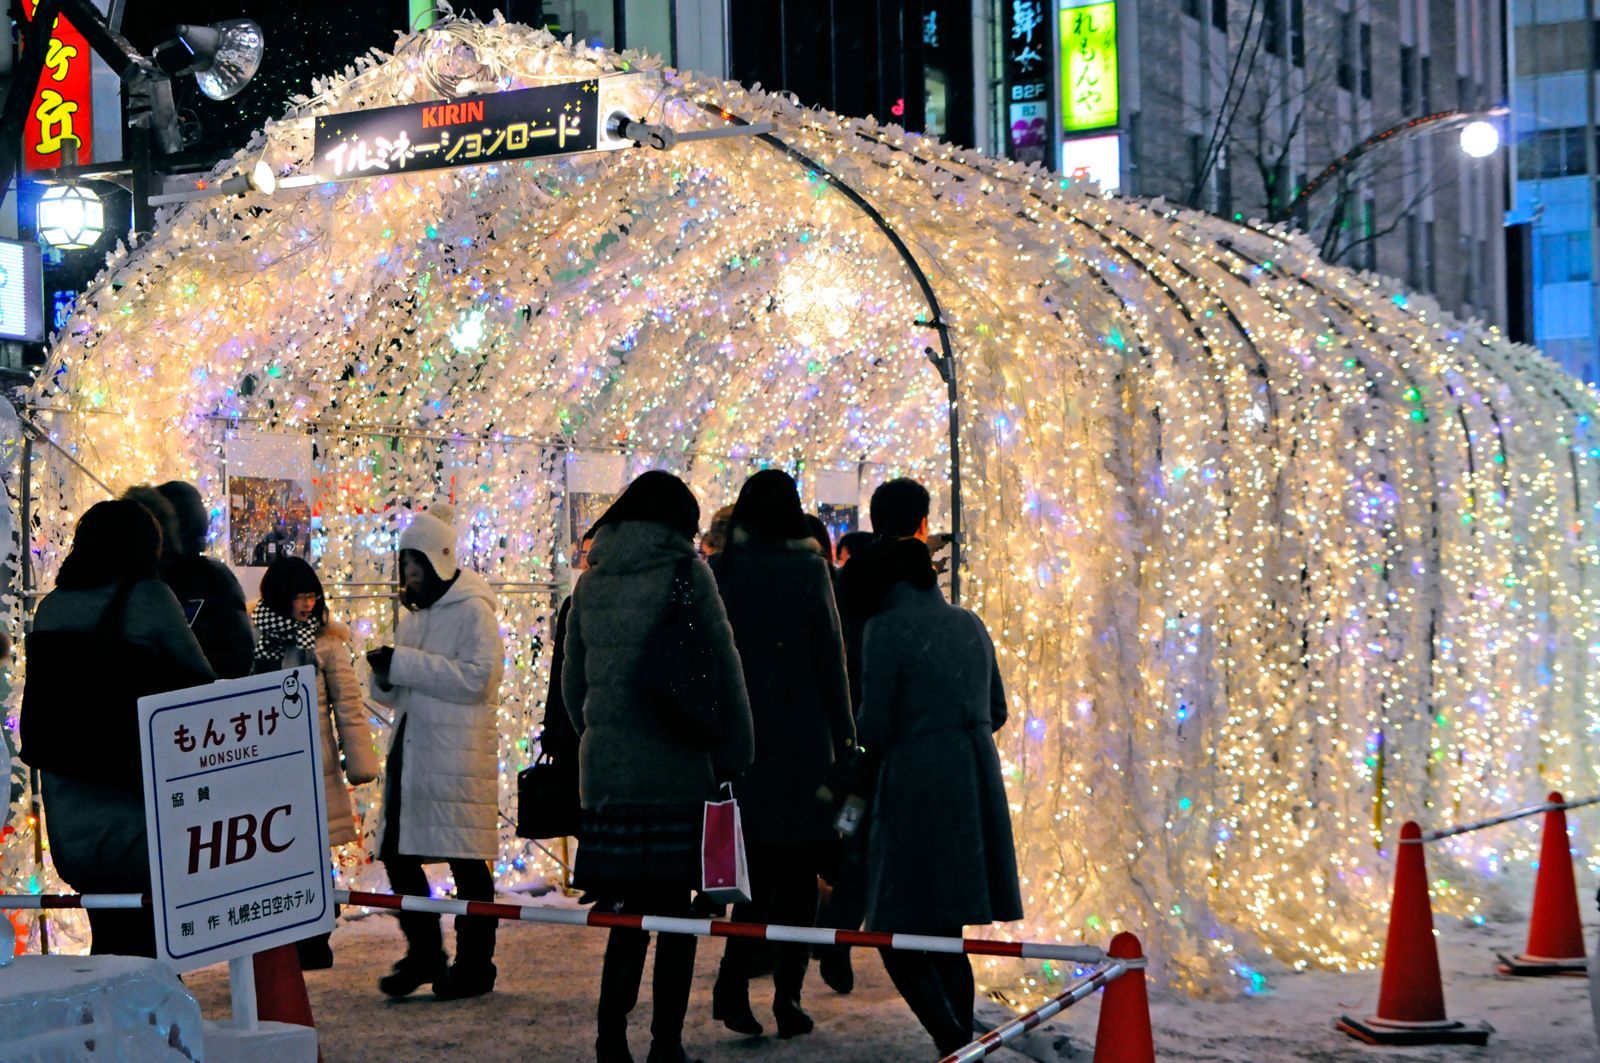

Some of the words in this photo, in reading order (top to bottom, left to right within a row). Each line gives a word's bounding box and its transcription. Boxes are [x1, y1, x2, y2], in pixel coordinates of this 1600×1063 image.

[1073, 12, 1102, 111] れもんや
[1011, 84, 1045, 100] B2F
[1022, 105, 1037, 117] B2
[422, 100, 484, 129] KIRIN
[325, 113, 581, 176] イルミネーションロード
[173, 706, 279, 753] もんすけ
[200, 745, 259, 768] MONSUKE
[186, 804, 296, 875] HBC
